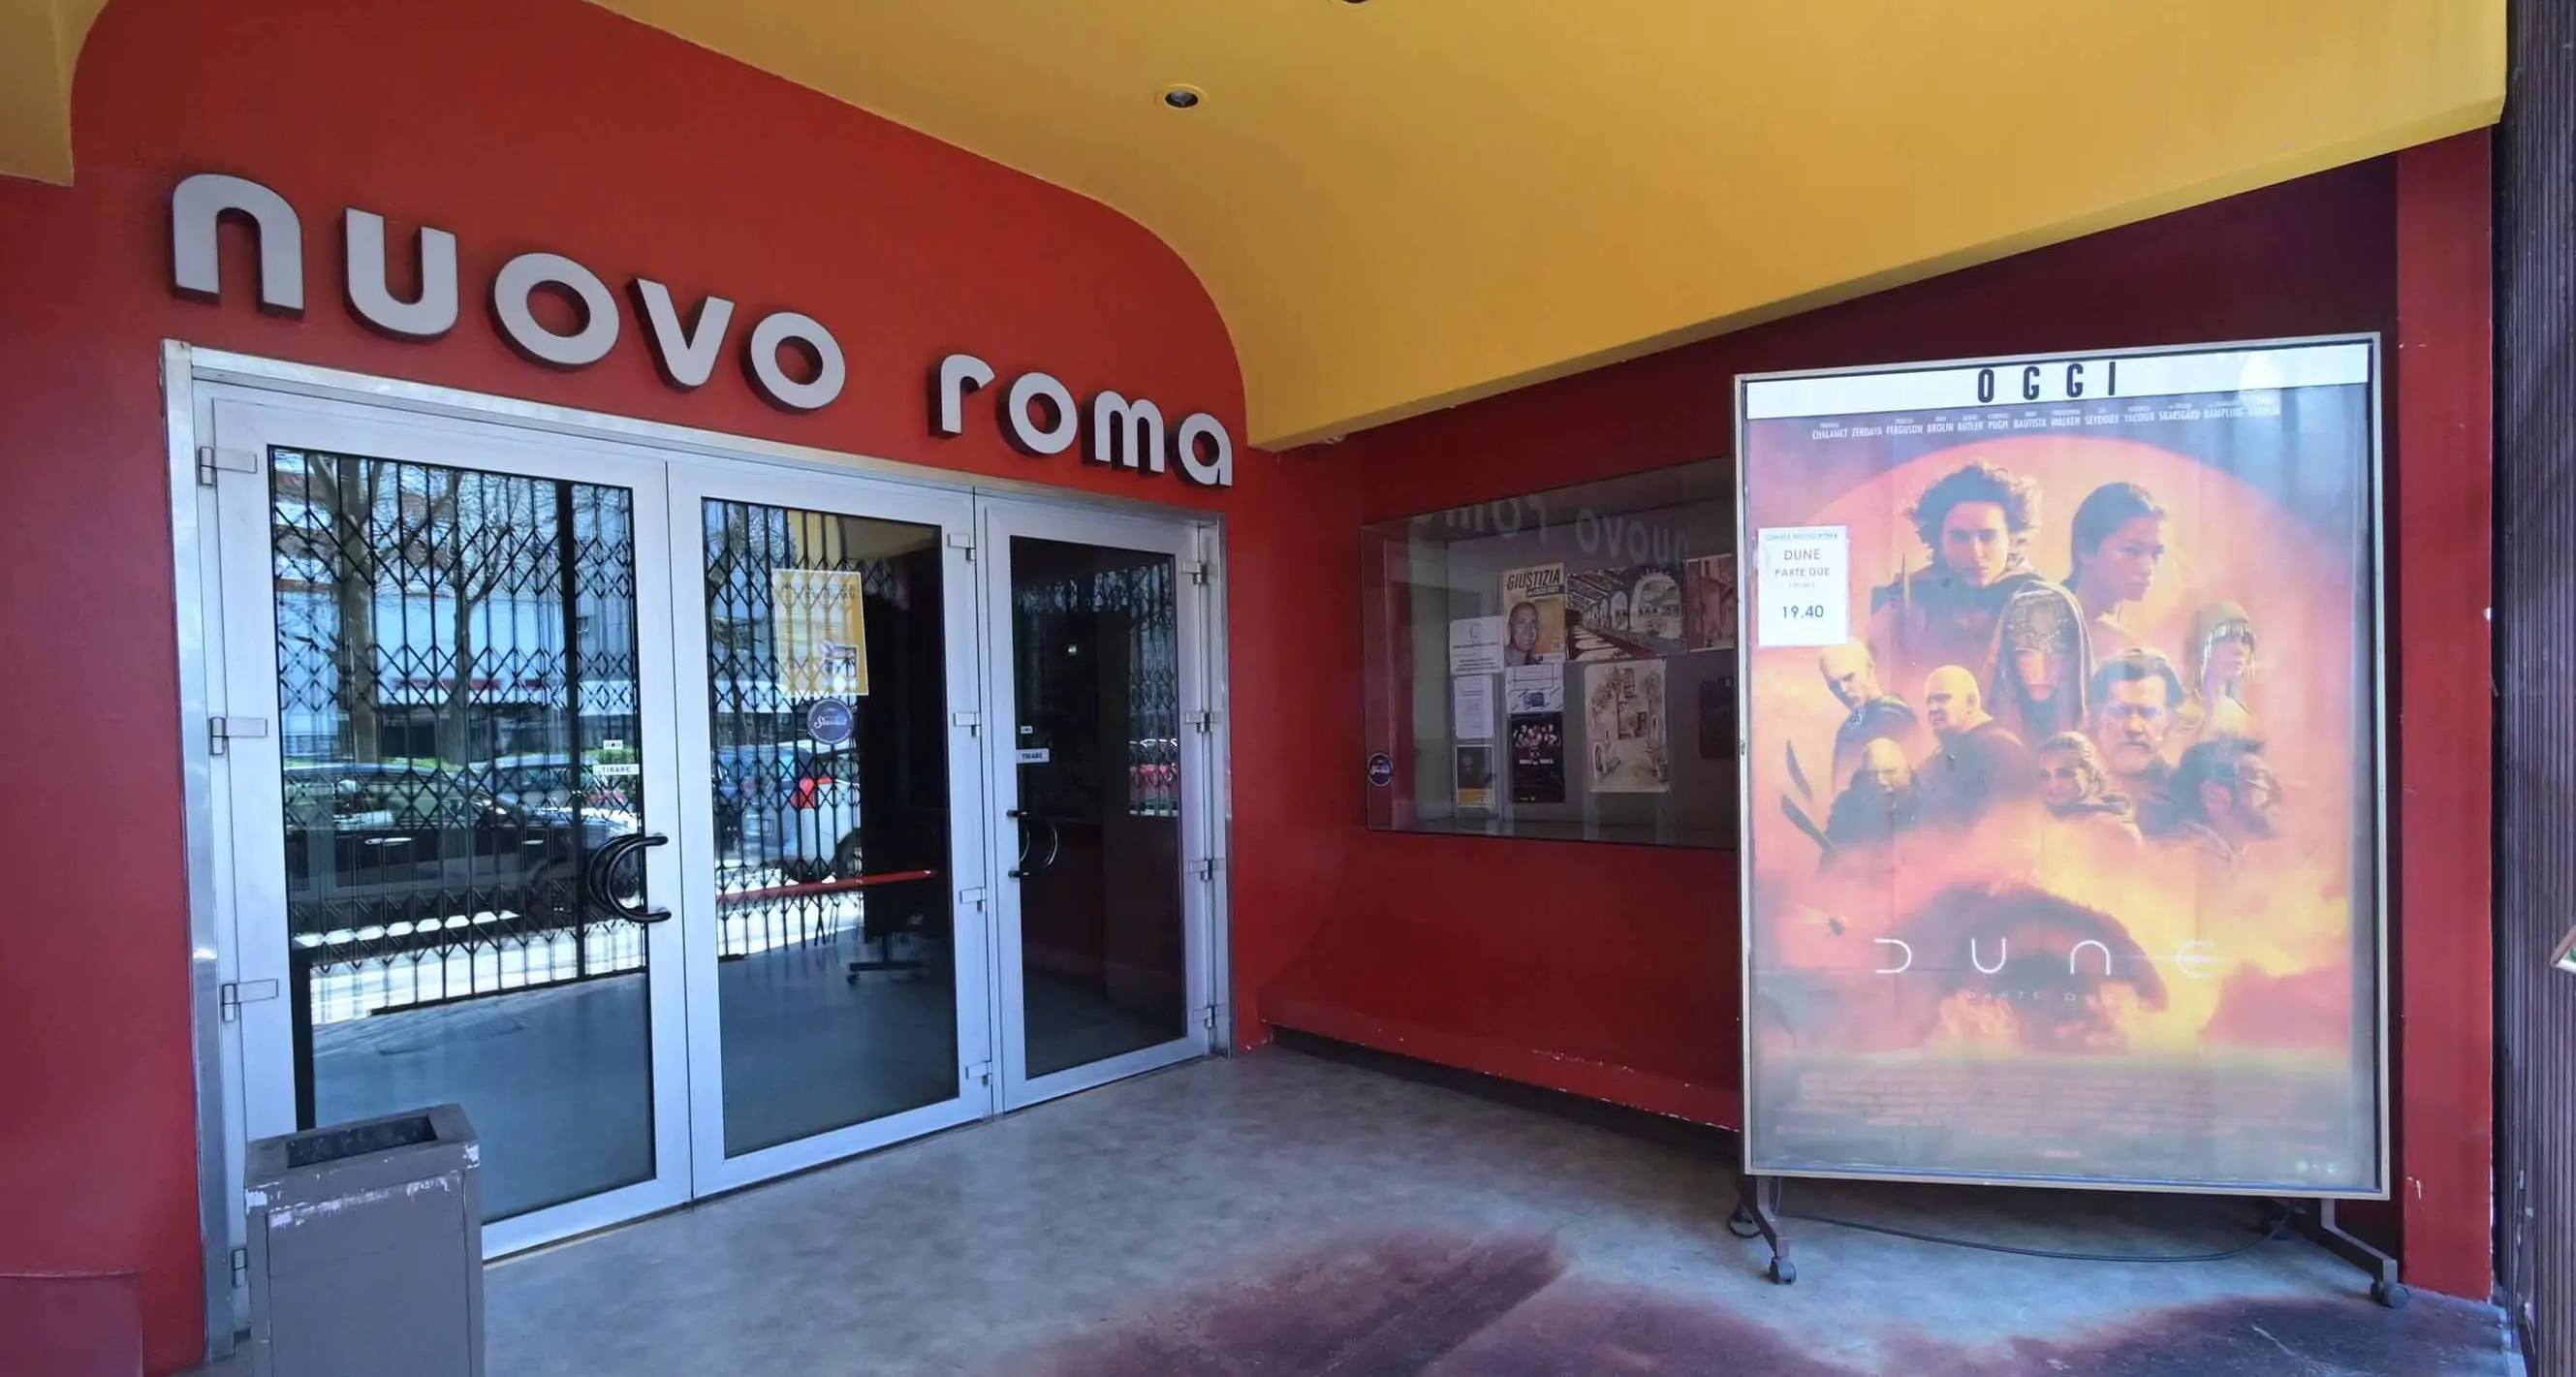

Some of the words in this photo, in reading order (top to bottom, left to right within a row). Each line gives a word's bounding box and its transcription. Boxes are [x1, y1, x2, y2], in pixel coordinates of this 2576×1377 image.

[172, 173, 846, 412] nuovo
[929, 353, 1233, 487] roma
[1978, 361, 2116, 403] OGGI
[1783, 548, 1821, 561] DUNE
[1507, 568, 1560, 591] GIUSTIZIA
[1775, 568, 1806, 577] PARTE
[1808, 568, 1831, 577] DUE
[1782, 605, 1825, 619] 19.40
[1874, 938, 2215, 978] DUNE
